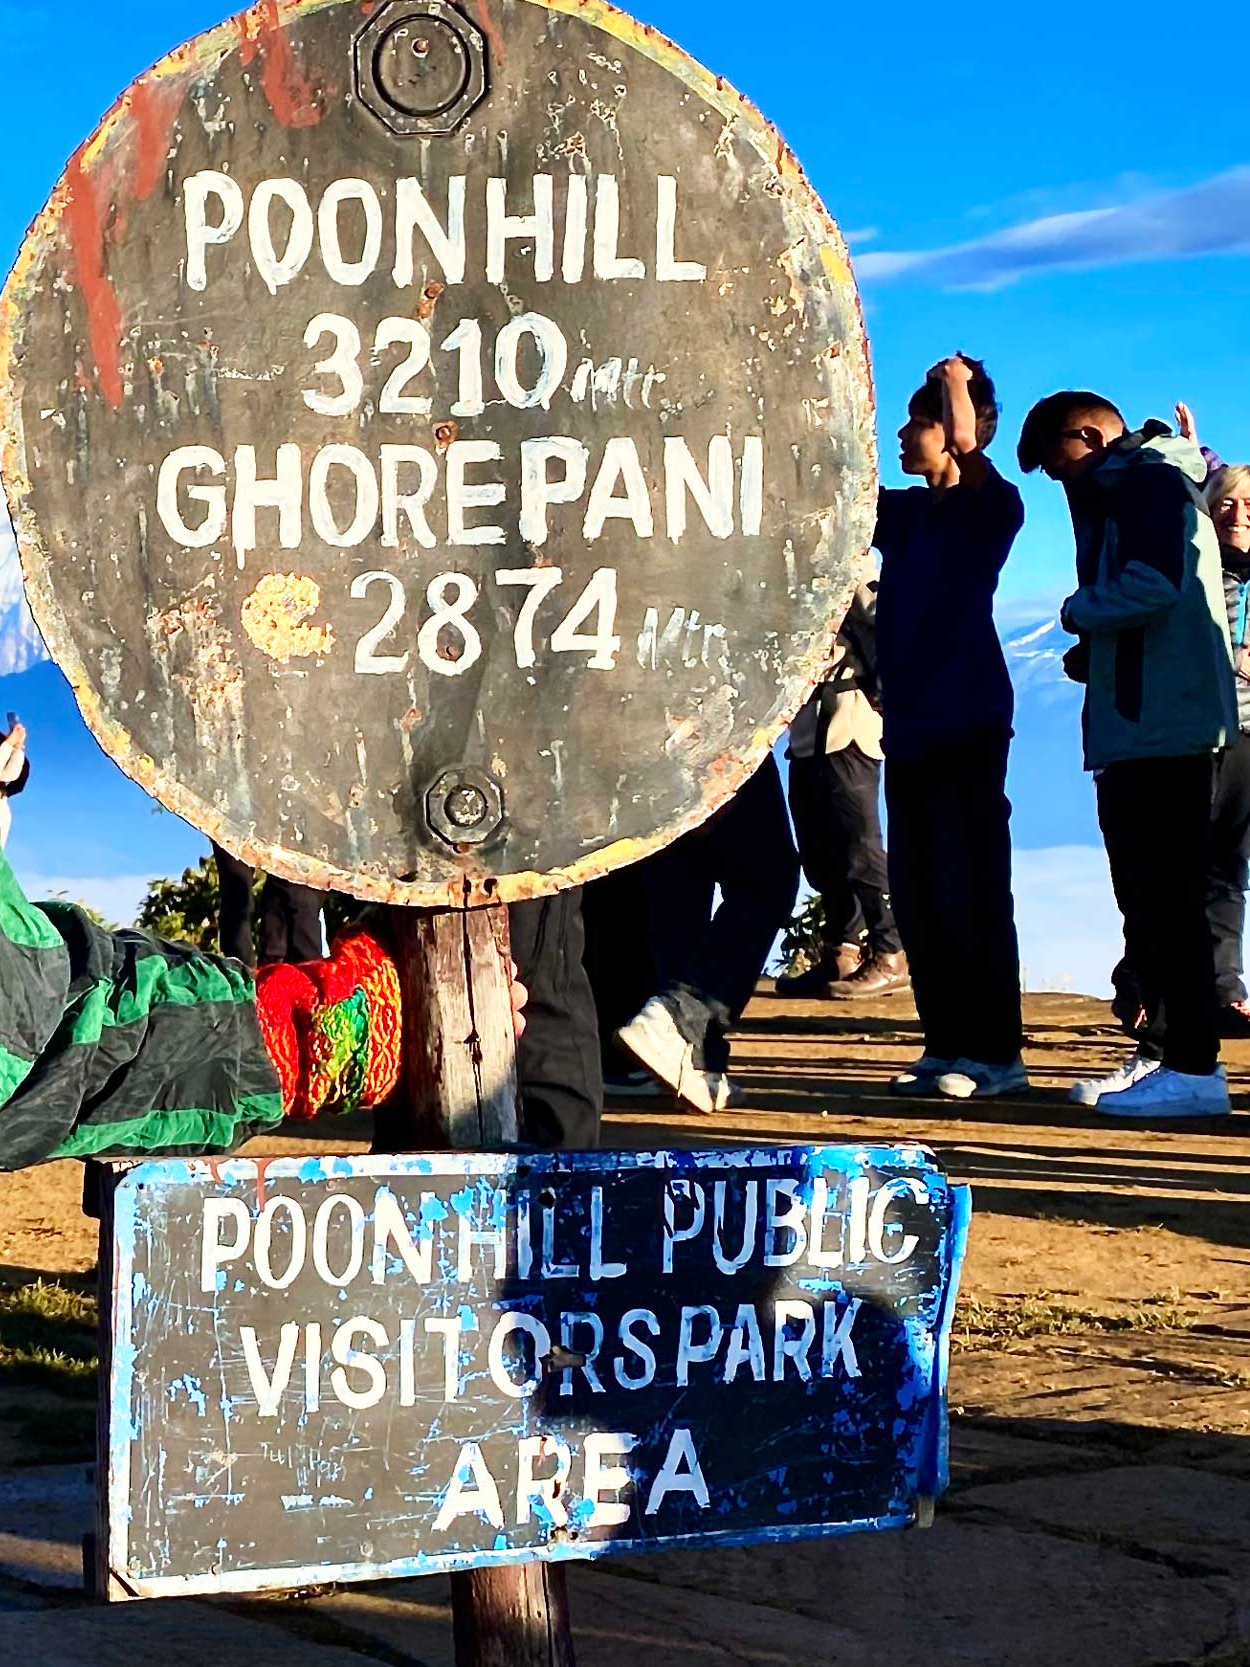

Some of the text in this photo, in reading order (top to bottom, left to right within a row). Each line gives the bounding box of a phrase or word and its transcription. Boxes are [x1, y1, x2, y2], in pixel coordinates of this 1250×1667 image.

[302, 311, 568, 417] 3210
[156, 435, 765, 562] GHOREPANI
[349, 566, 621, 676] 2874
[662, 1176, 930, 1275] PUBLIC
[431, 1428, 711, 1533] AREA
